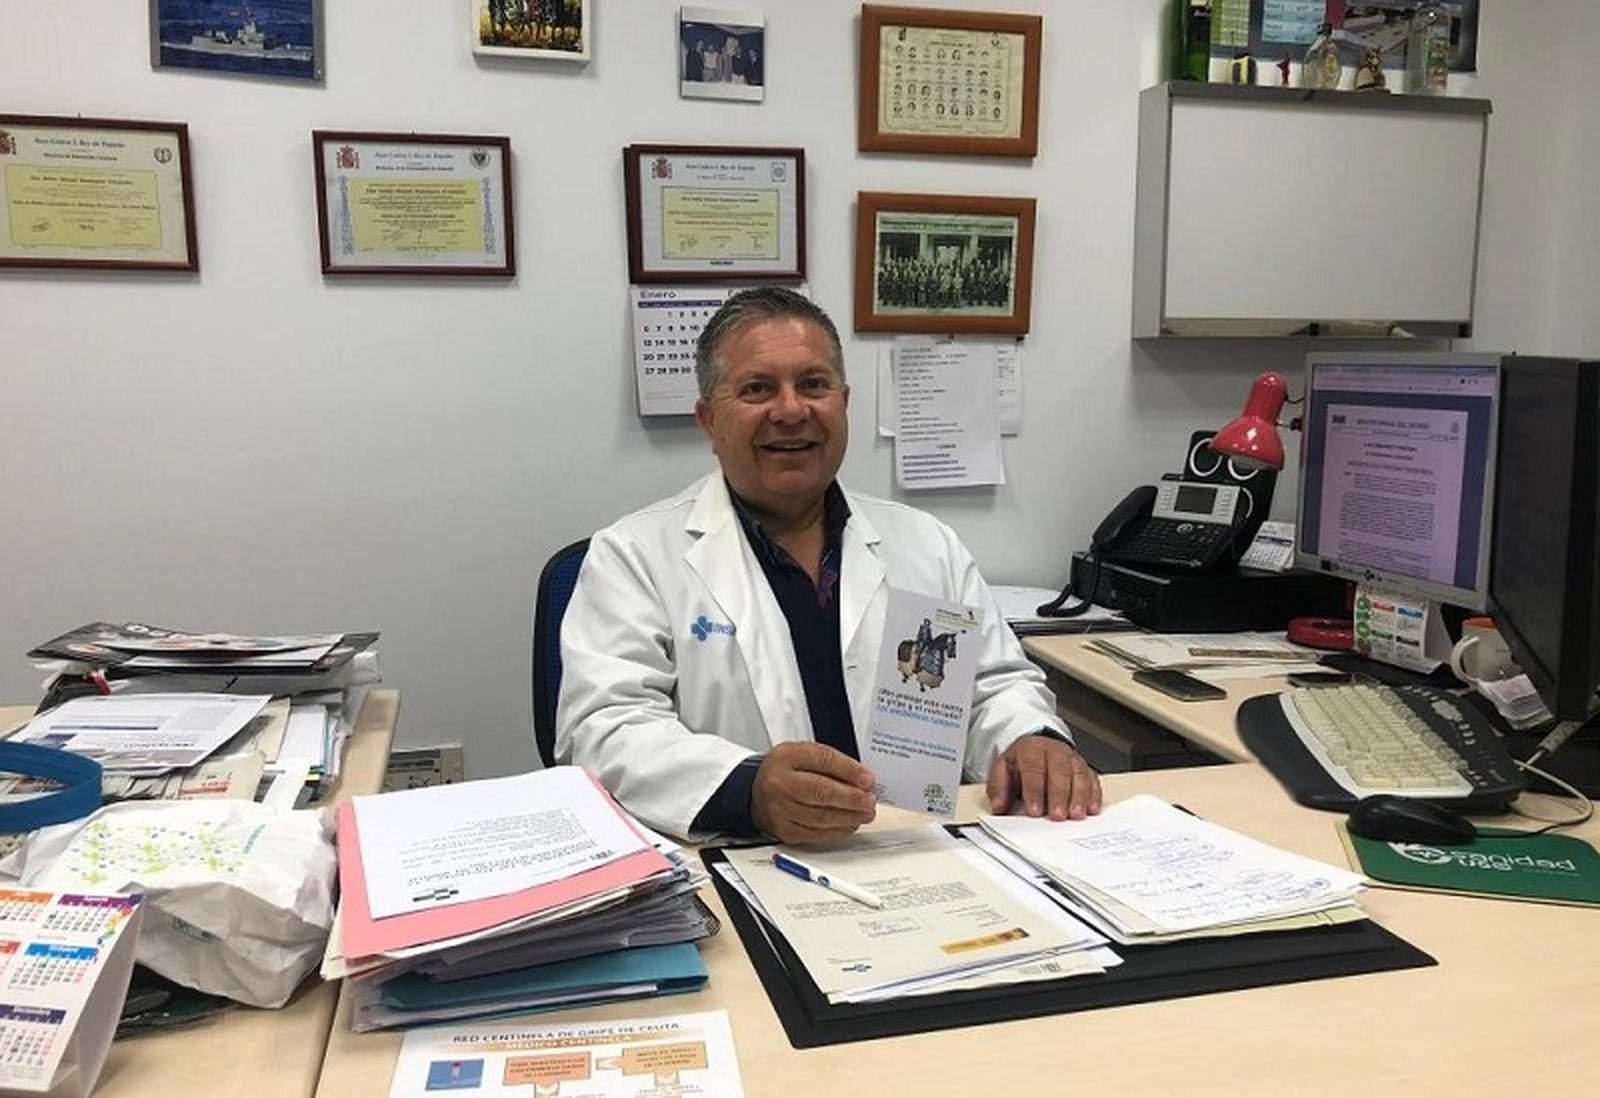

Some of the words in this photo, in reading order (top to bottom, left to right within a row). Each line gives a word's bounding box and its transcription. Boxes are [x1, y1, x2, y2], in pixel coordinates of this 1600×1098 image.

[640, 290, 677, 299] Enero
[453, 1034, 480, 1043] RED
[483, 1031, 555, 1042] CENTINELA
[559, 1030, 573, 1038] DE
[577, 1028, 614, 1037] GRIPE
[618, 1026, 634, 1034] DE
[638, 1022, 680, 1032] CEUTA
